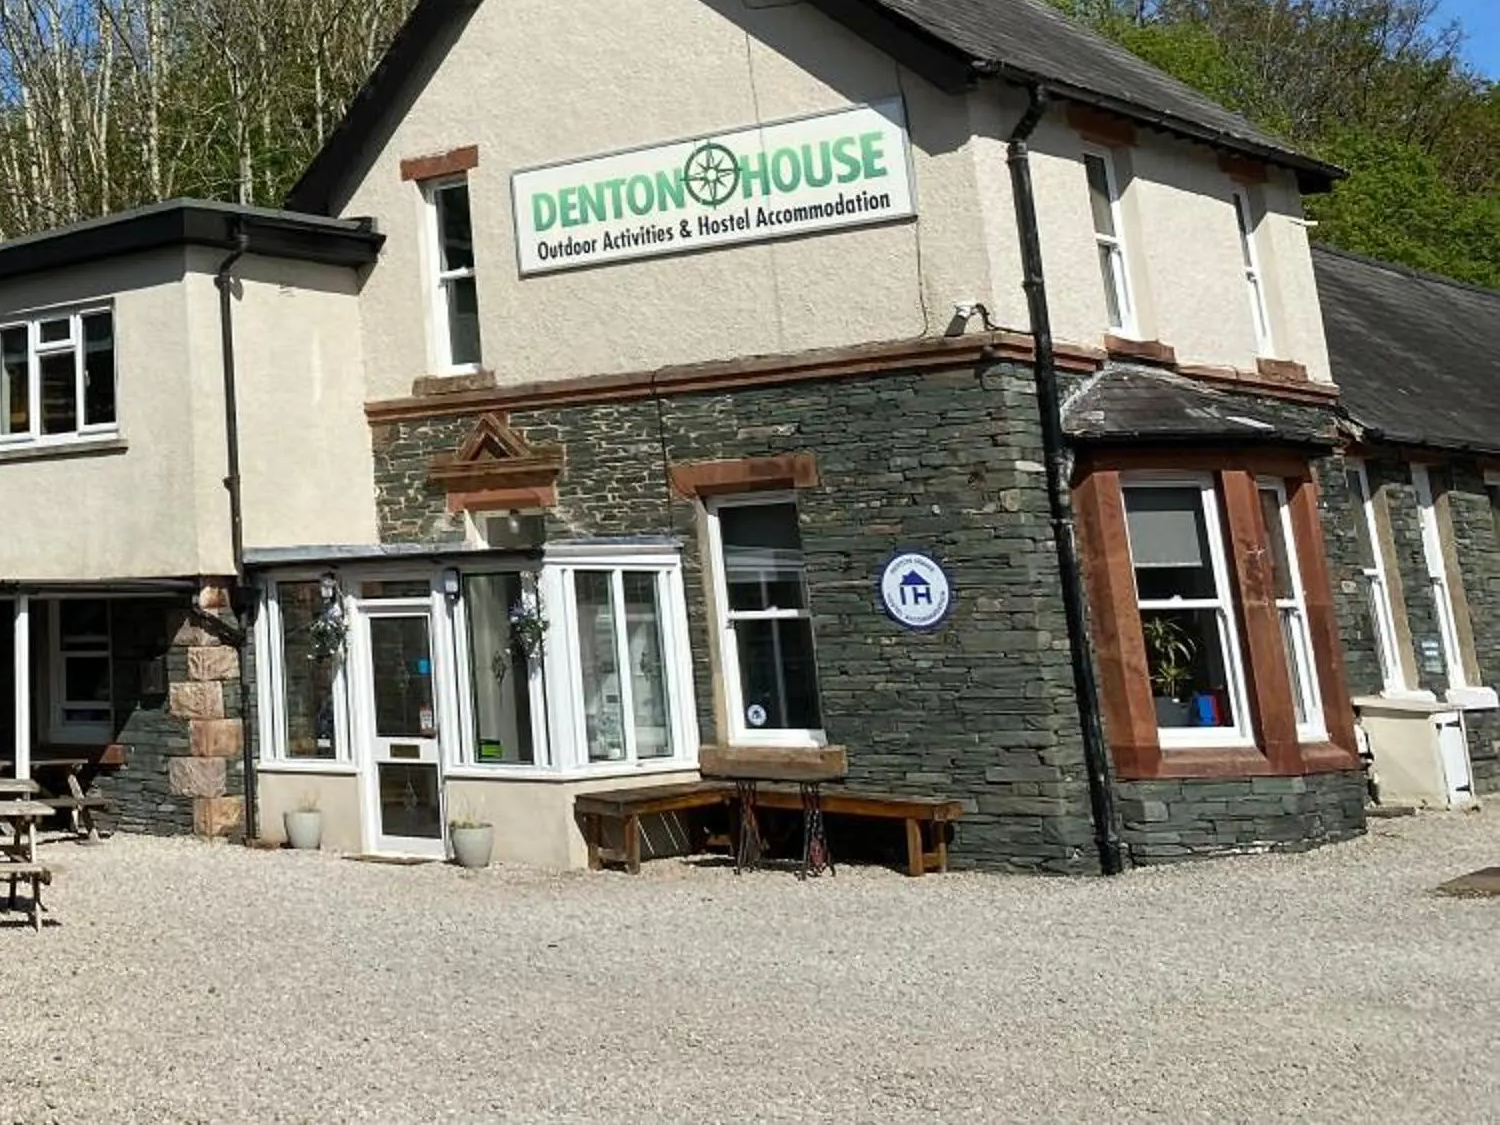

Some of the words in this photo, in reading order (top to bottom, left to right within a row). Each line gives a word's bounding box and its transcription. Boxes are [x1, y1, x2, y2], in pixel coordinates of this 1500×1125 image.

[531, 168, 686, 232] DENTON
[739, 131, 889, 200] HOUSE
[537, 235, 598, 261] Outdoor
[602, 225, 674, 252] Activities
[679, 219, 693, 239] &
[698, 207, 752, 236] Hostel
[755, 190, 891, 228] Accommodation
